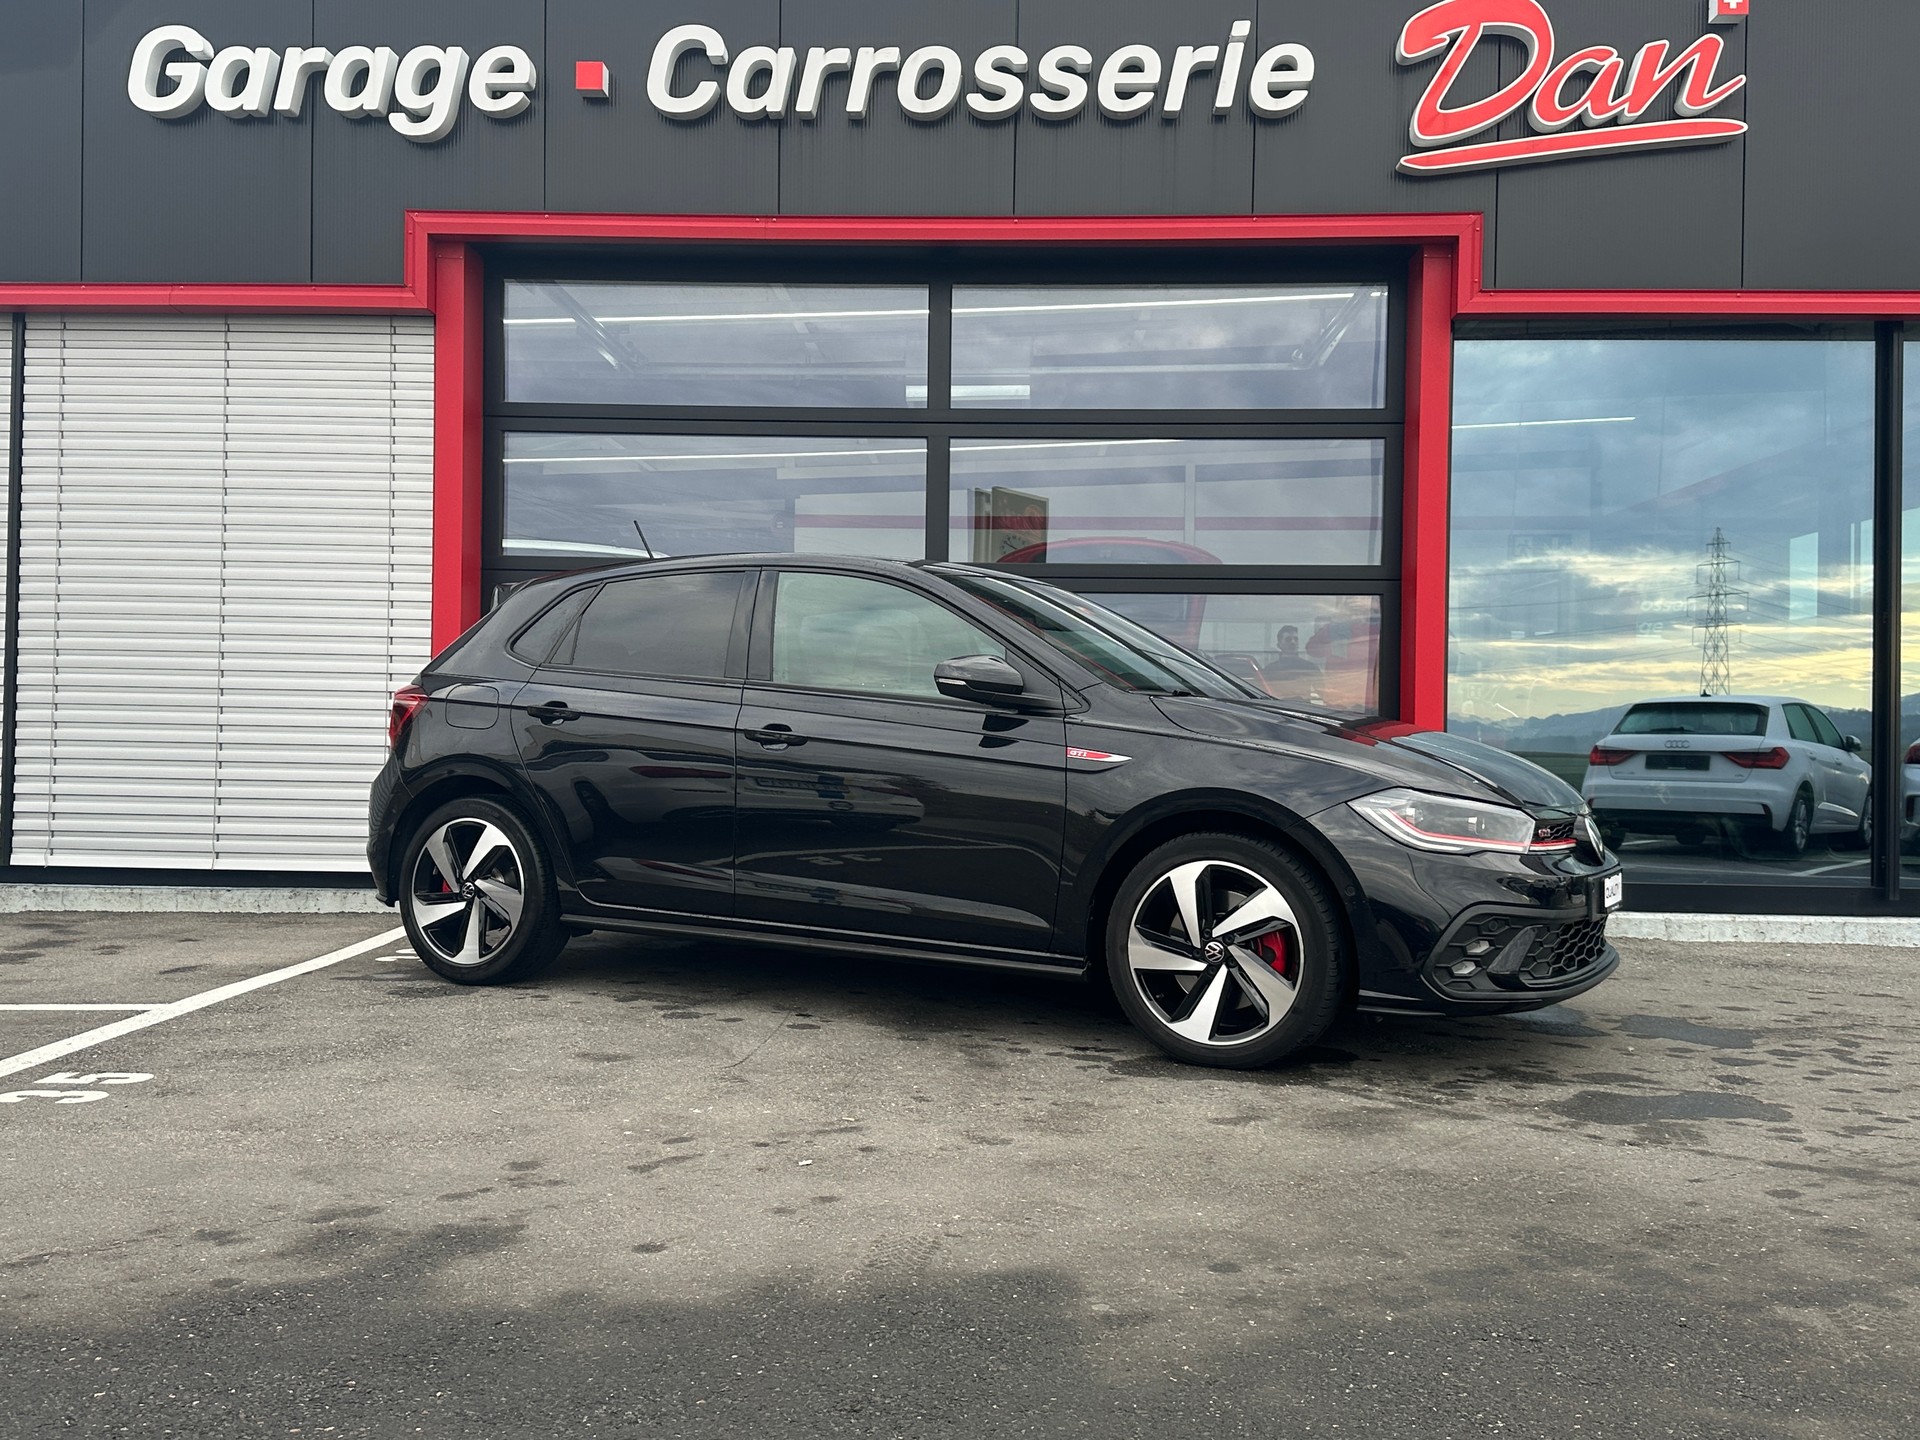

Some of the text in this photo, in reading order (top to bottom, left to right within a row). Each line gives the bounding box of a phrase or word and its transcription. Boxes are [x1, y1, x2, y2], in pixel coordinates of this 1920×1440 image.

[127, 0, 1746, 146] Garage Carrosserie Dan
[1069, 749, 1088, 758] GTI
[0, 1071, 155, 1104] 35
